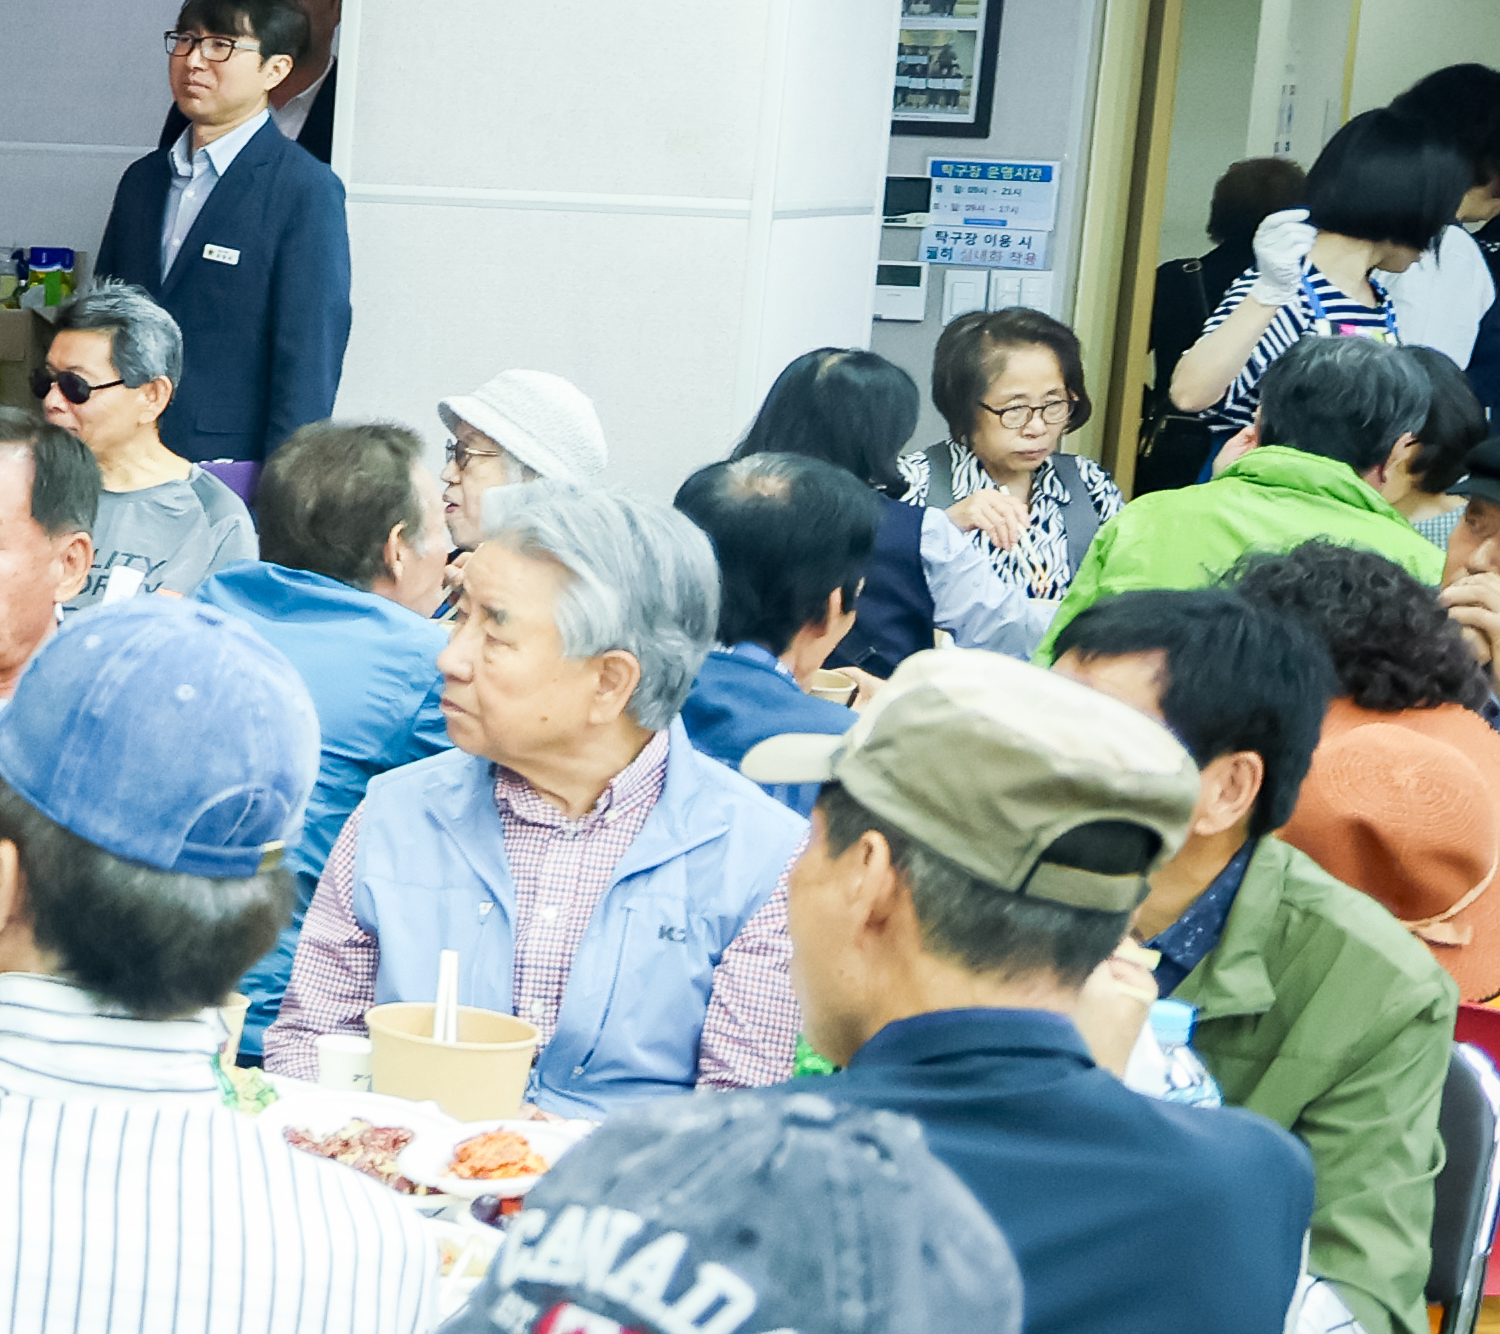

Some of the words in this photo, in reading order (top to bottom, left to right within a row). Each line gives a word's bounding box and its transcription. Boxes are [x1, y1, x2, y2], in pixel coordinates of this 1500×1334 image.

[935, 231, 977, 246] 탁구장
[984, 233, 1012, 249] 이용
[1019, 236, 1032, 249] 시
